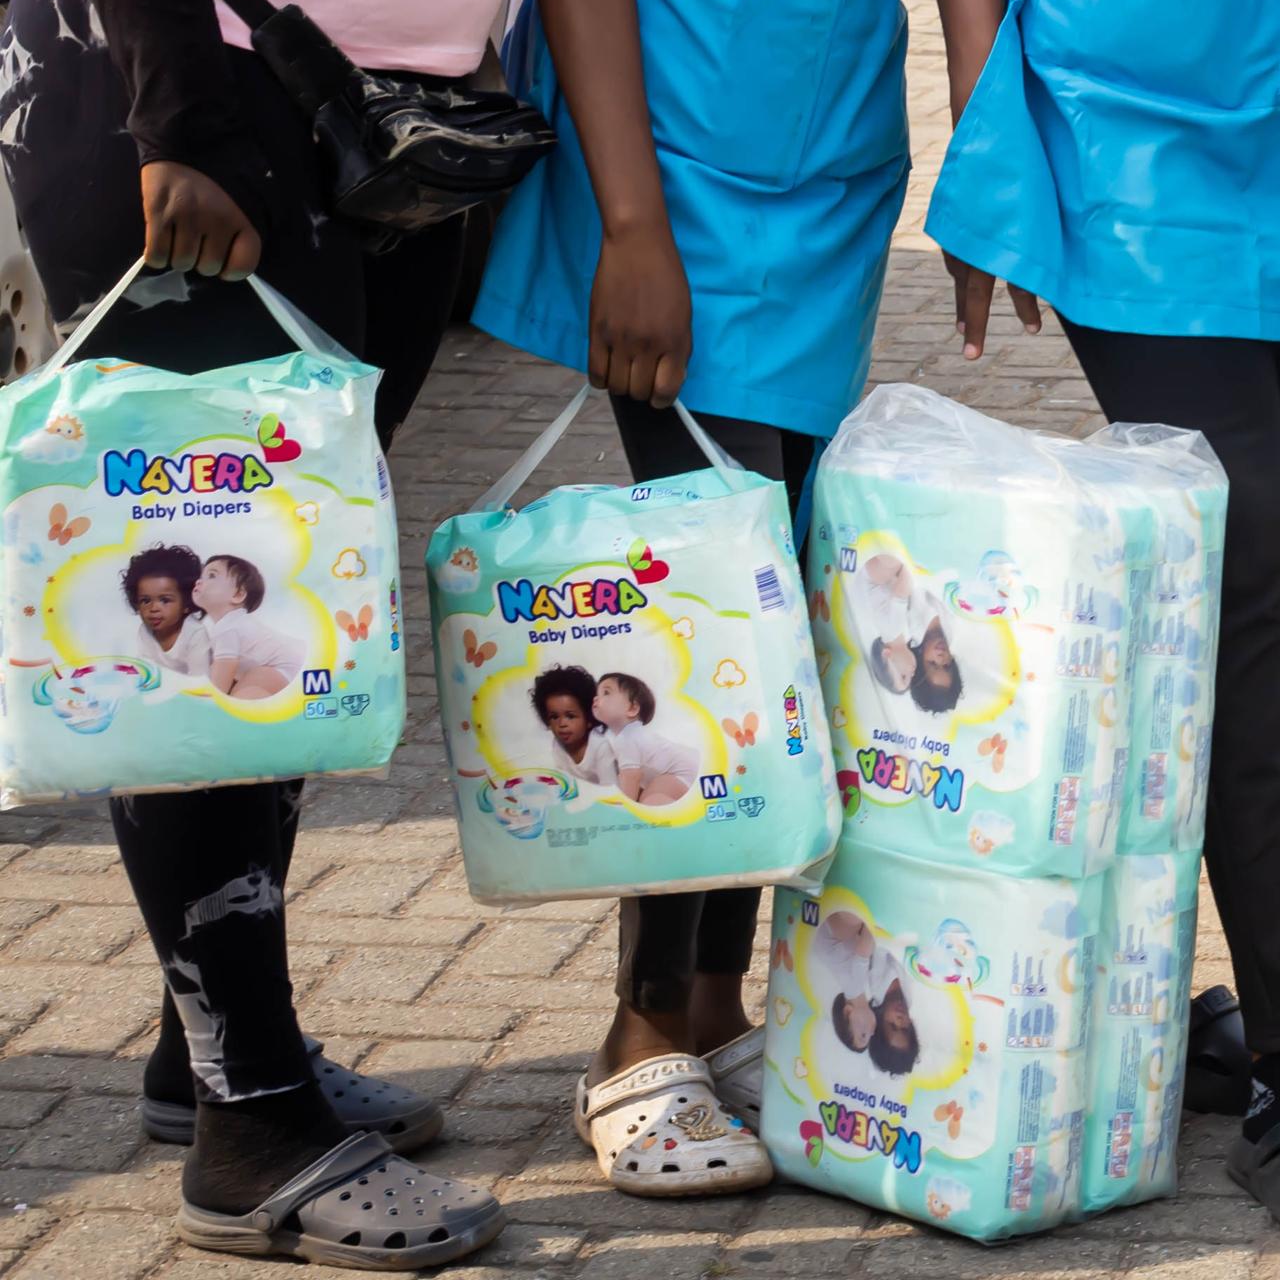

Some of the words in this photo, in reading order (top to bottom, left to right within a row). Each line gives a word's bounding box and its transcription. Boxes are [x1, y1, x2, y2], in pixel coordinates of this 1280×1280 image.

[103, 449, 274, 497] NAVERA
[632, 488, 650, 500] M
[131, 503, 177, 521] Baby
[183, 500, 252, 519] Diapers
[496, 578, 648, 623] NAVERA
[528, 627, 566, 644] Baby
[571, 622, 632, 641] Diapers
[305, 670, 330, 694] M
[307, 702, 325, 716] 50
[873, 728, 917, 750] Diapers
[920, 738, 950, 757] Baby
[703, 776, 726, 798] M
[857, 747, 965, 813] NAVERA
[804, 902, 819, 925] M
[834, 1082, 877, 1107] Diapers
[880, 1099, 908, 1120] Baby
[818, 1100, 922, 1174] NAVERA
